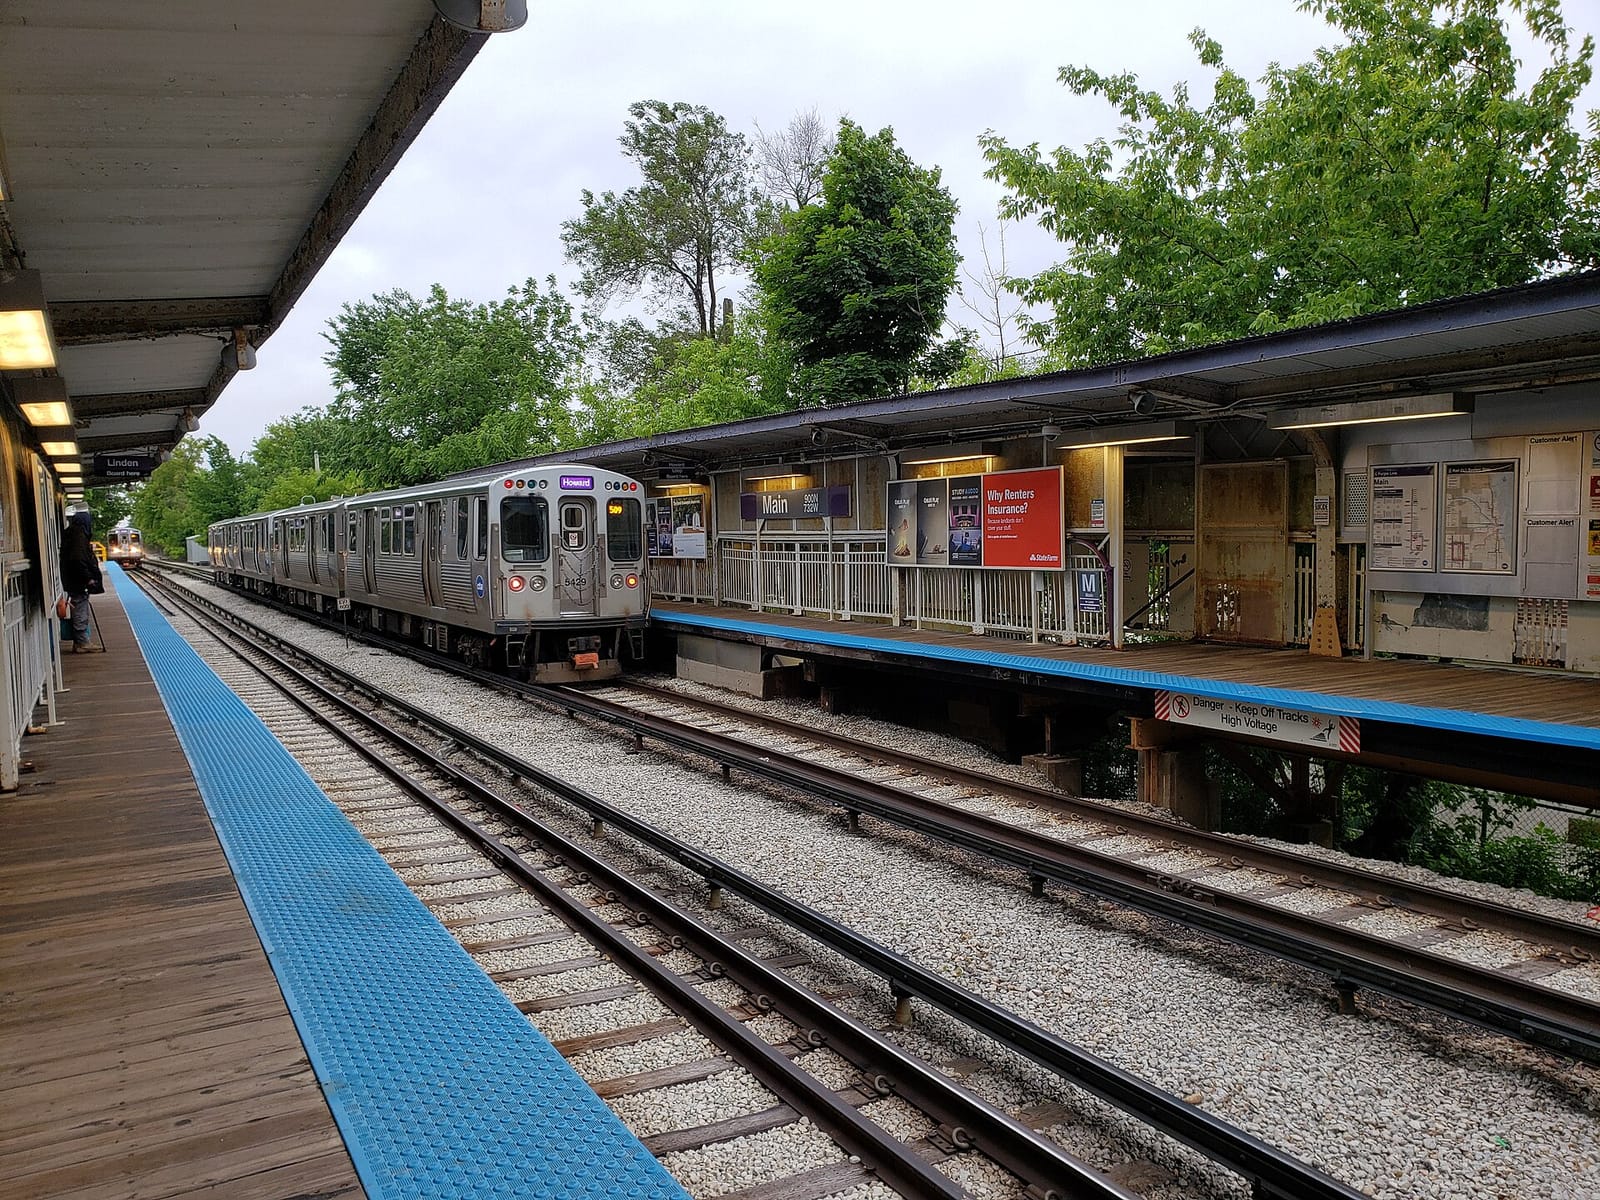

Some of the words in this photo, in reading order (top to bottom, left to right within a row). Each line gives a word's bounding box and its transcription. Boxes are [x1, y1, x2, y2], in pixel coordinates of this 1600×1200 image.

[1530, 436, 1561, 444] Customer
[107, 459, 139, 467] Linden
[562, 478, 590, 487] Howard
[1374, 478, 1389, 486] Main
[804, 493, 819, 503] 900N
[987, 490, 1004, 503] Why
[1004, 488, 1035, 500] Renters
[762, 494, 788, 514] Main
[803, 503, 819, 513] 732W
[987, 502, 1028, 515] Insurance?
[608, 505, 623, 514] 509
[564, 578, 586, 586] 5429
[1081, 573, 1096, 592] M
[1193, 696, 1225, 711] Danger
[1235, 703, 1259, 716] Keep
[1260, 706, 1276, 717] Off
[1276, 708, 1309, 724] Tracks
[1221, 713, 1242, 727] High
[1243, 716, 1278, 733] Voltage
